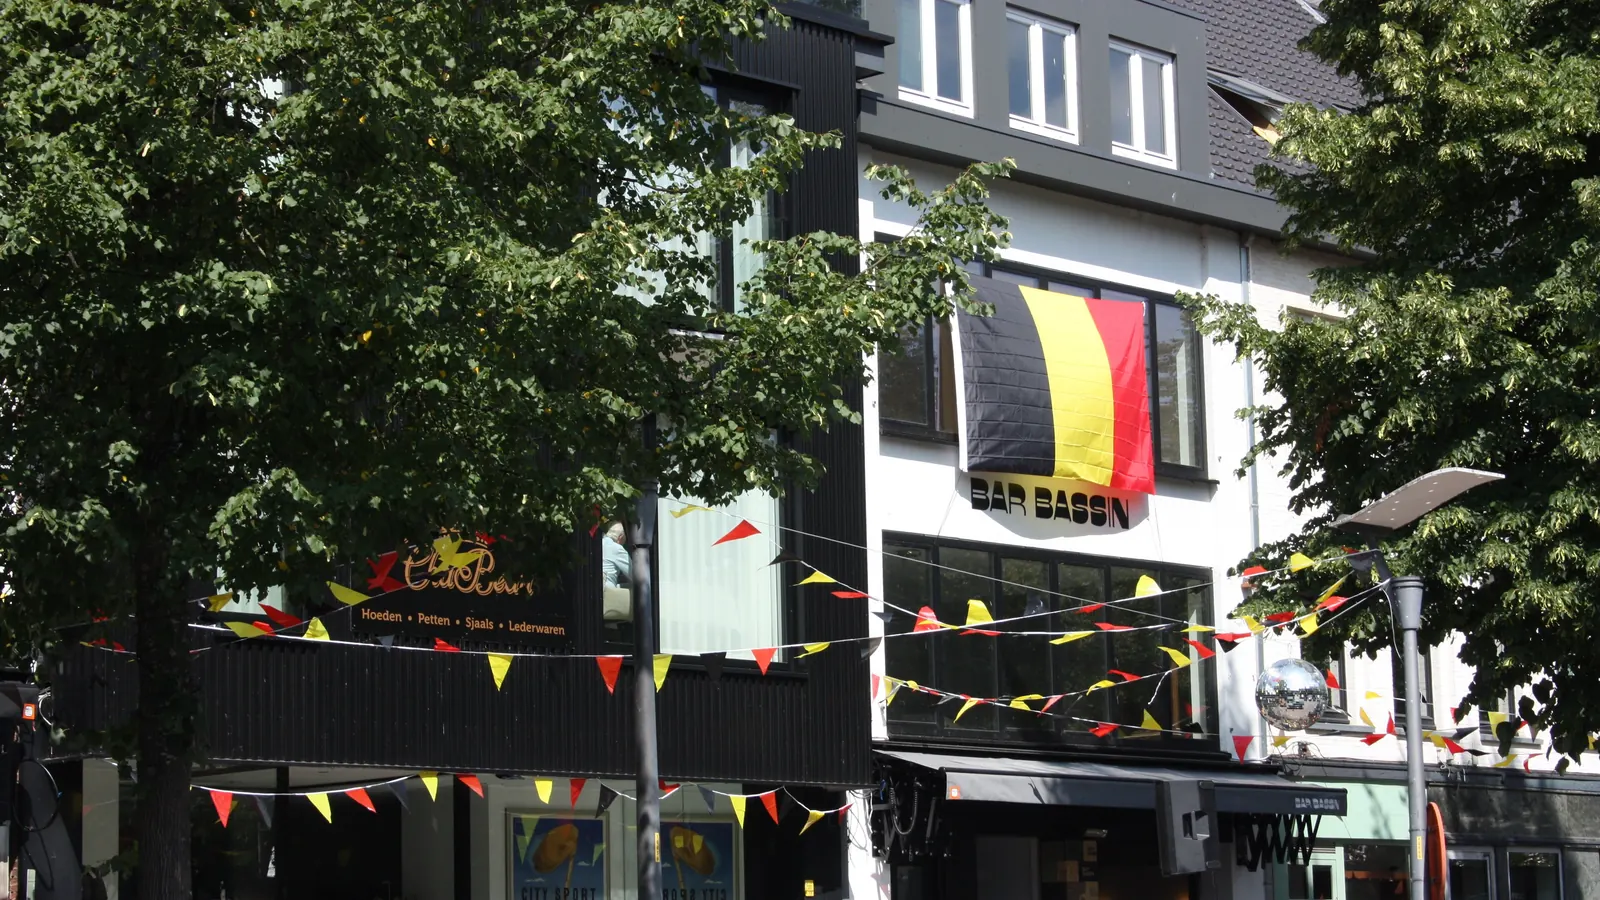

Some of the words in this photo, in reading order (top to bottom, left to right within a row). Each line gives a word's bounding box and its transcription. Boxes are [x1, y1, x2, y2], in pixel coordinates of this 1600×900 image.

[970, 477, 1027, 516] BAR
[1034, 486, 1130, 530] BASSIN
[361, 608, 402, 622] Hoeden
[418, 612, 451, 626] Petten
[465, 617, 494, 631] Sjaals
[508, 620, 566, 635] Lederwaren
[521, 887, 548, 900] CITY
[555, 887, 596, 900] SPORT
